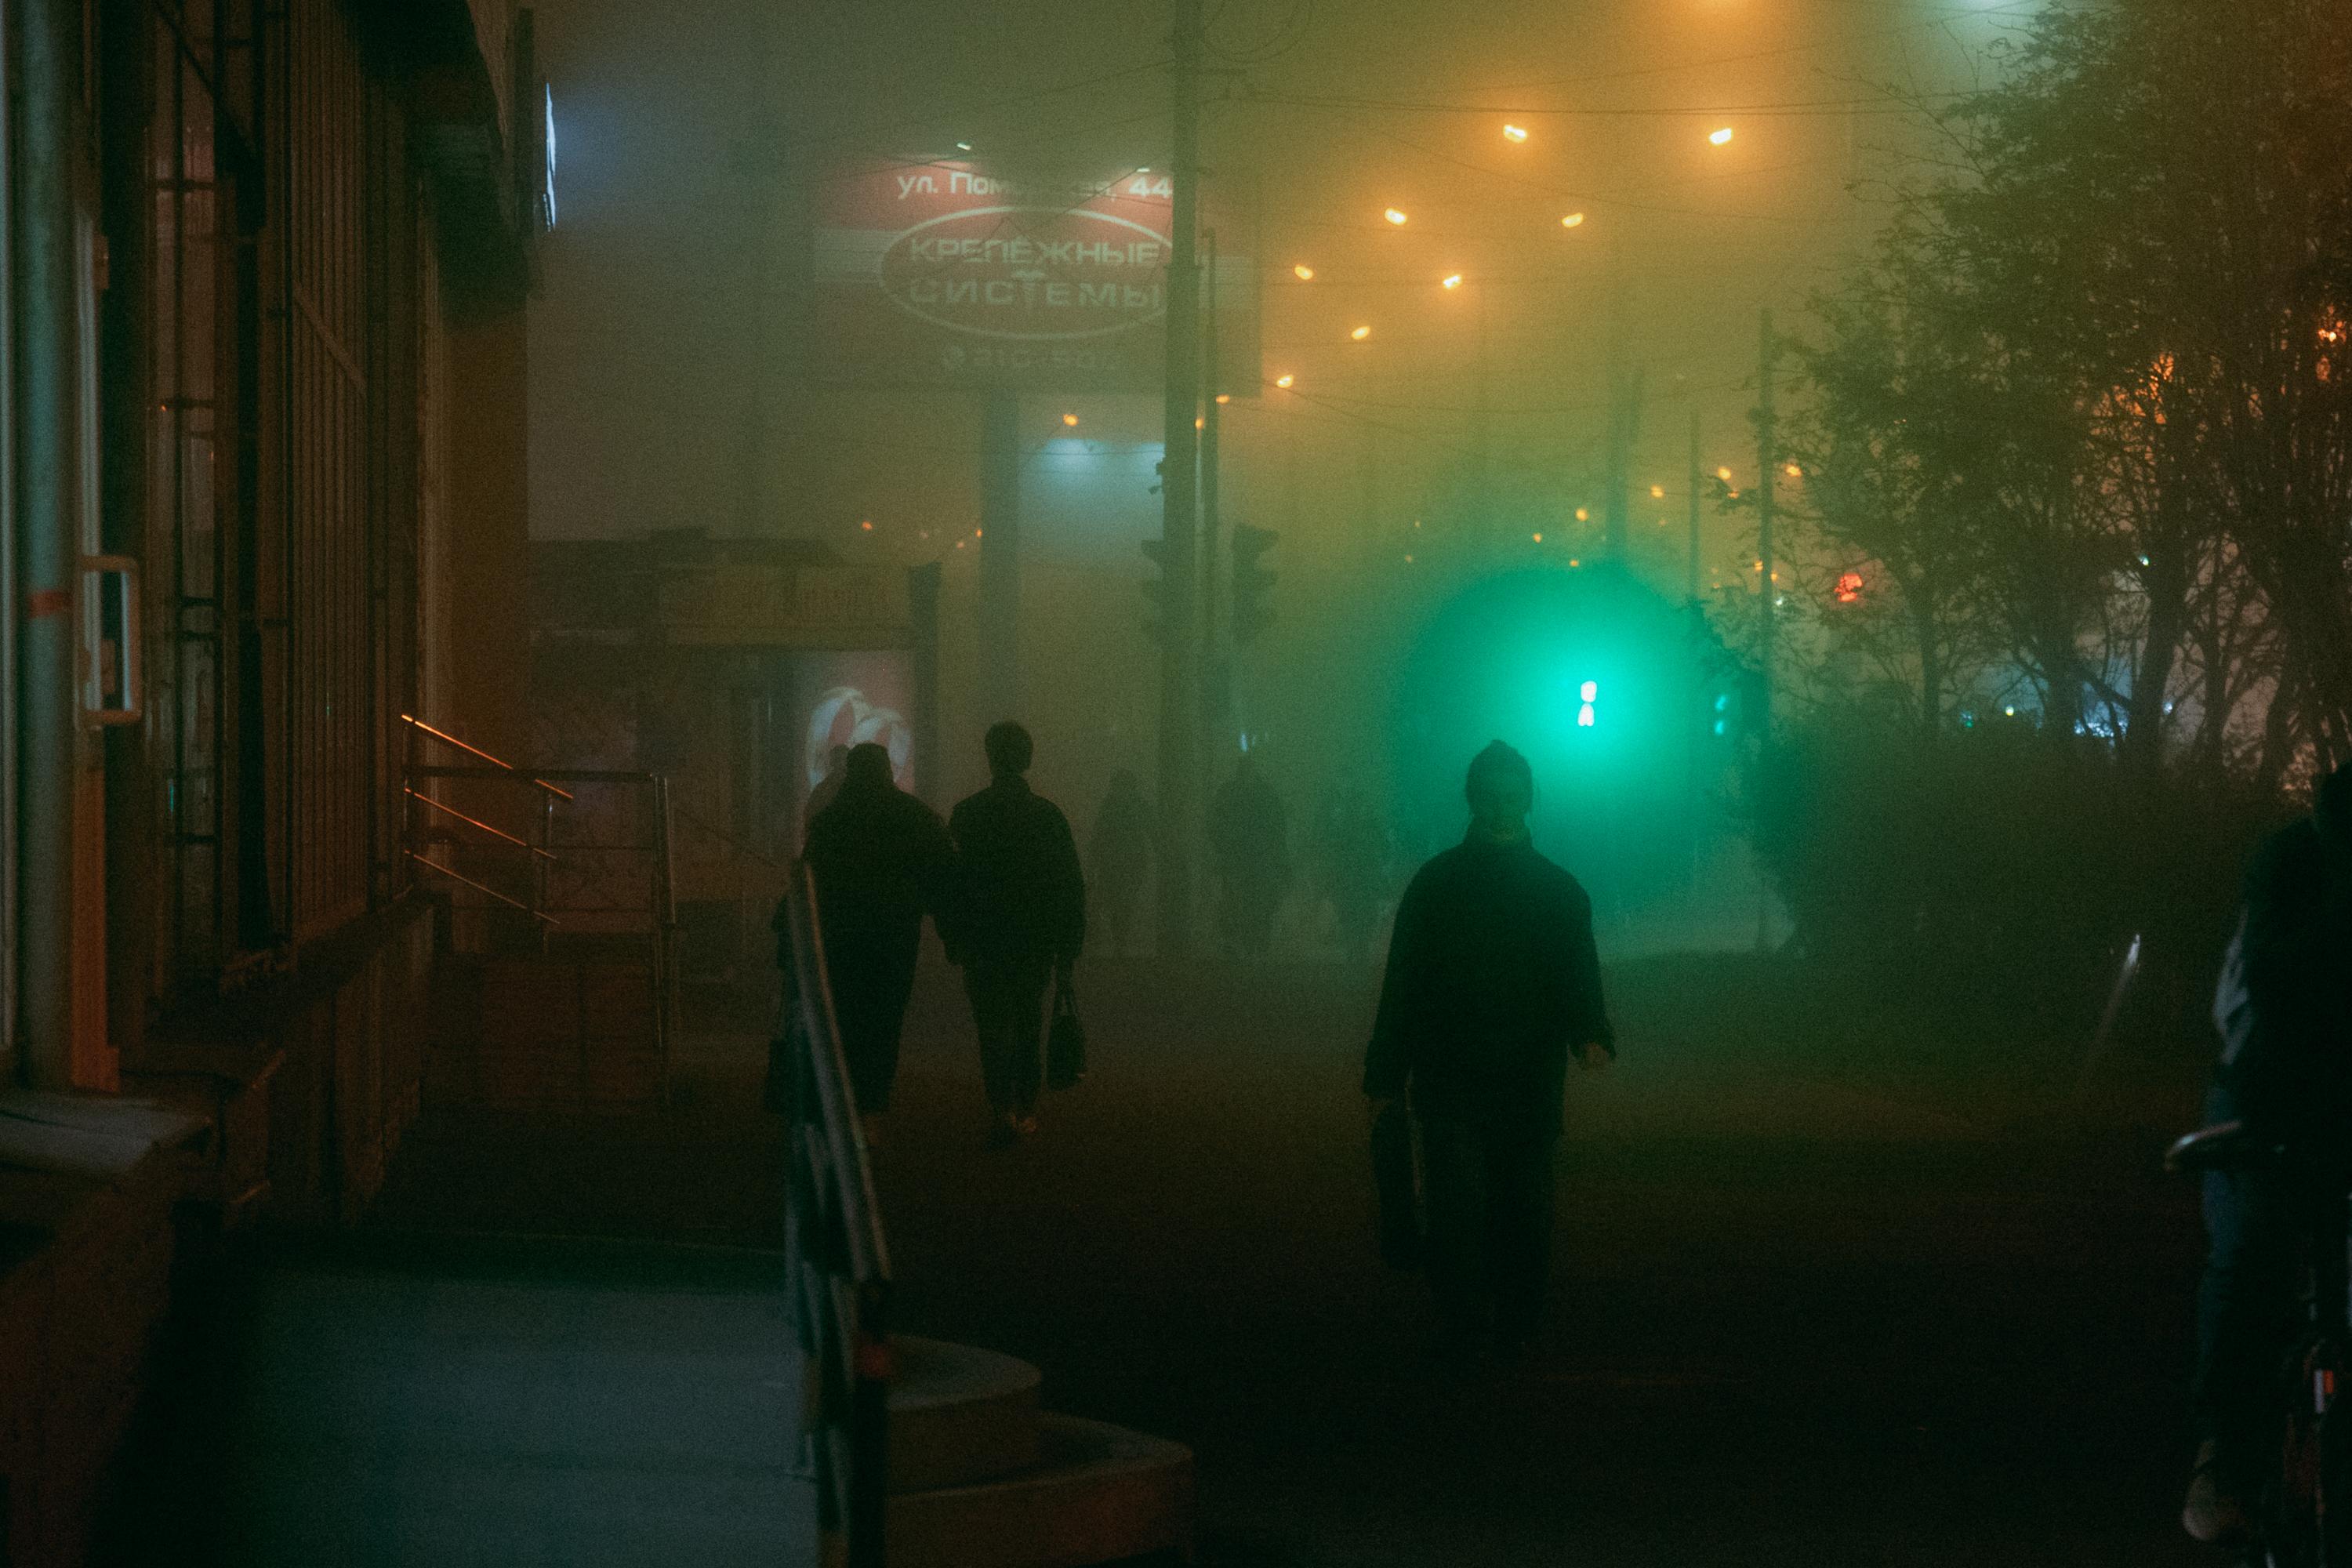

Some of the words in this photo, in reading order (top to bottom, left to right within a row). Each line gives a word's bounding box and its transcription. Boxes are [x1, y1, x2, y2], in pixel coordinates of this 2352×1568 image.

[897, 174, 938, 200] ул.
[1128, 176, 1172, 198] 44
[909, 270, 1160, 311] СИСТЕМЫ
